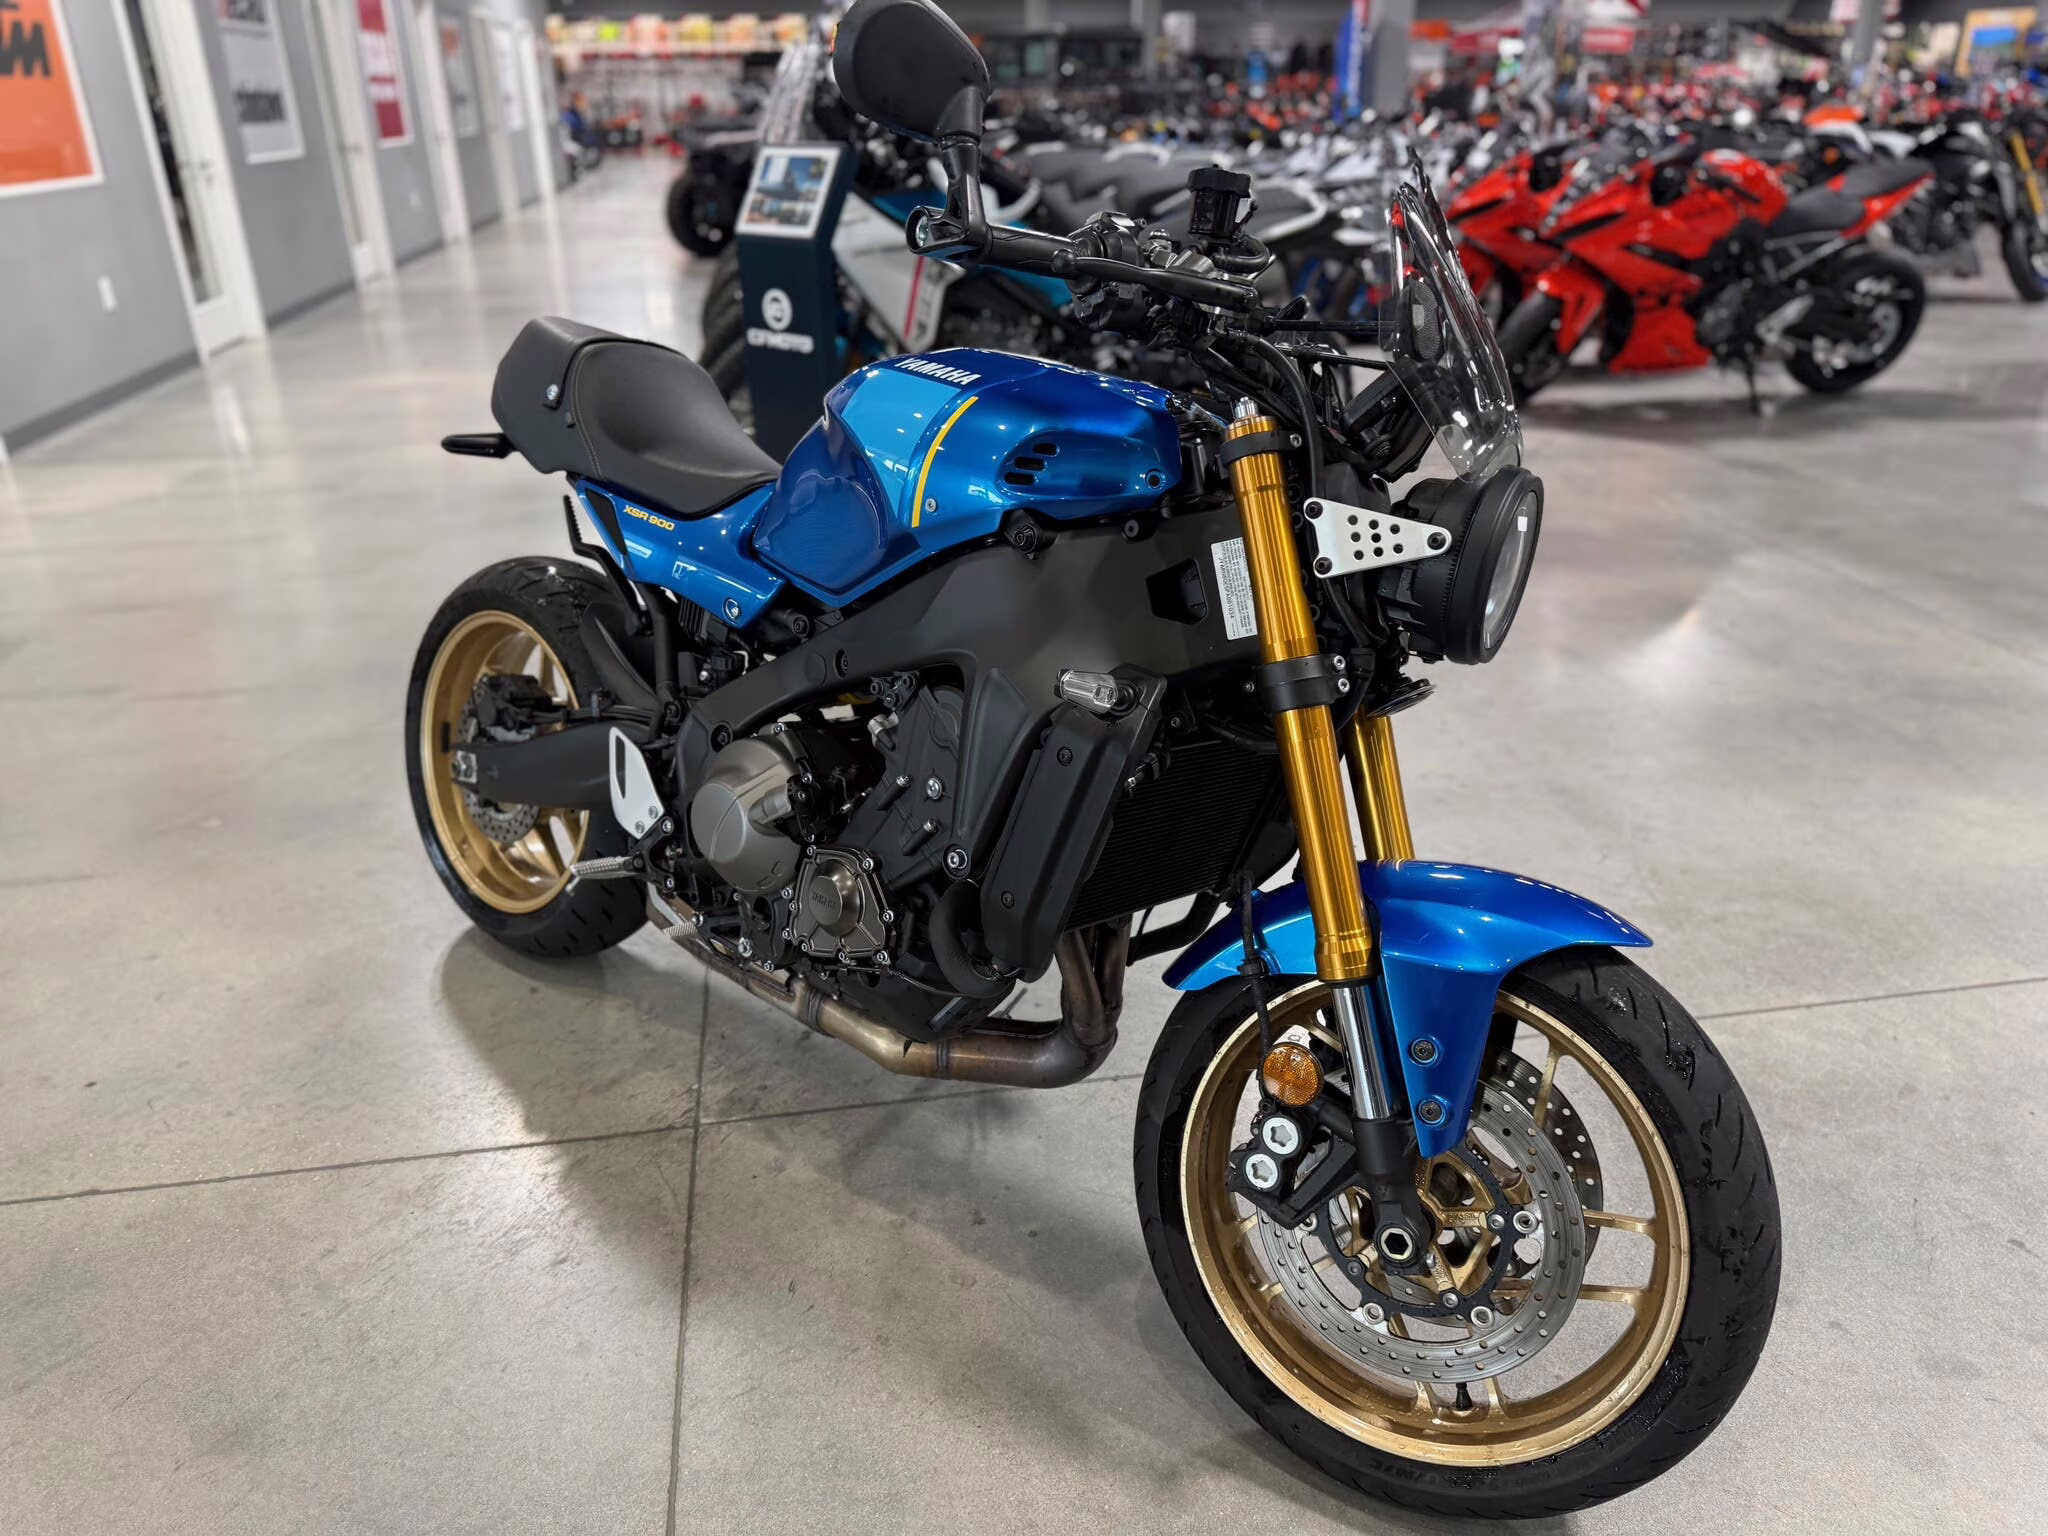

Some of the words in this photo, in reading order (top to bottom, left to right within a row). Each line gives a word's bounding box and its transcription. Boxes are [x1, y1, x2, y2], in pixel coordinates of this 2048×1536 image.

[894, 357, 982, 385] YAMAHA
[623, 505, 649, 520] XSR
[648, 515, 675, 530] 900
[812, 892, 837, 909] YAMAHA
